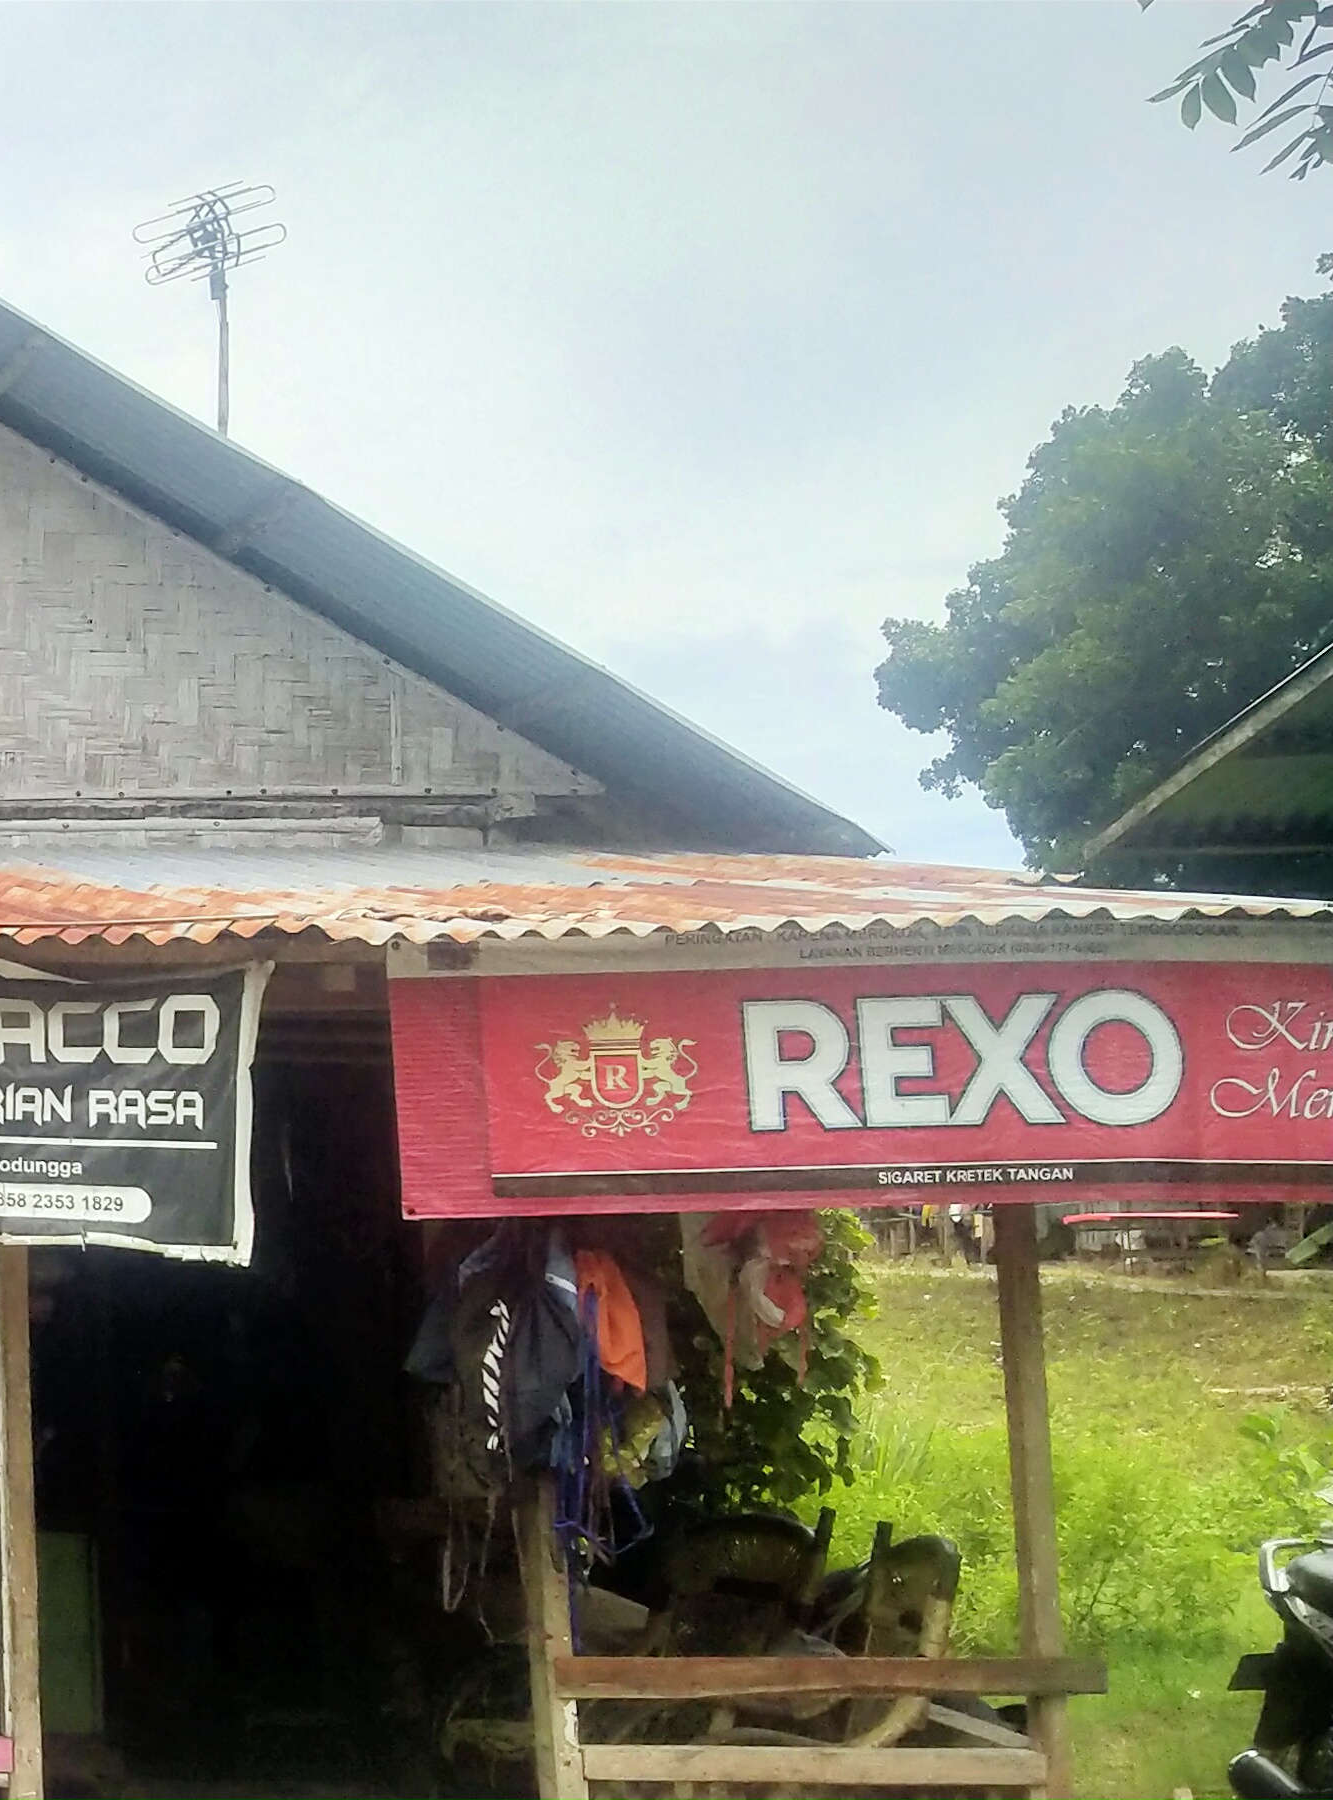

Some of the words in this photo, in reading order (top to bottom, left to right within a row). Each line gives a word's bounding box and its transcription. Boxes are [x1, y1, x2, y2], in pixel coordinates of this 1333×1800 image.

[664, 931, 763, 945] PERINGATAN
[603, 1061, 628, 1090] R
[742, 989, 1184, 1131] REXO
[88, 1088, 205, 1131] RASA
[878, 1170, 942, 1185] SIGARET
[946, 1168, 1003, 1183] KRETEK
[1006, 1167, 1074, 1181] TANGAN
[32, 1193, 75, 1210] 2353
[81, 1195, 124, 1212] 1829
